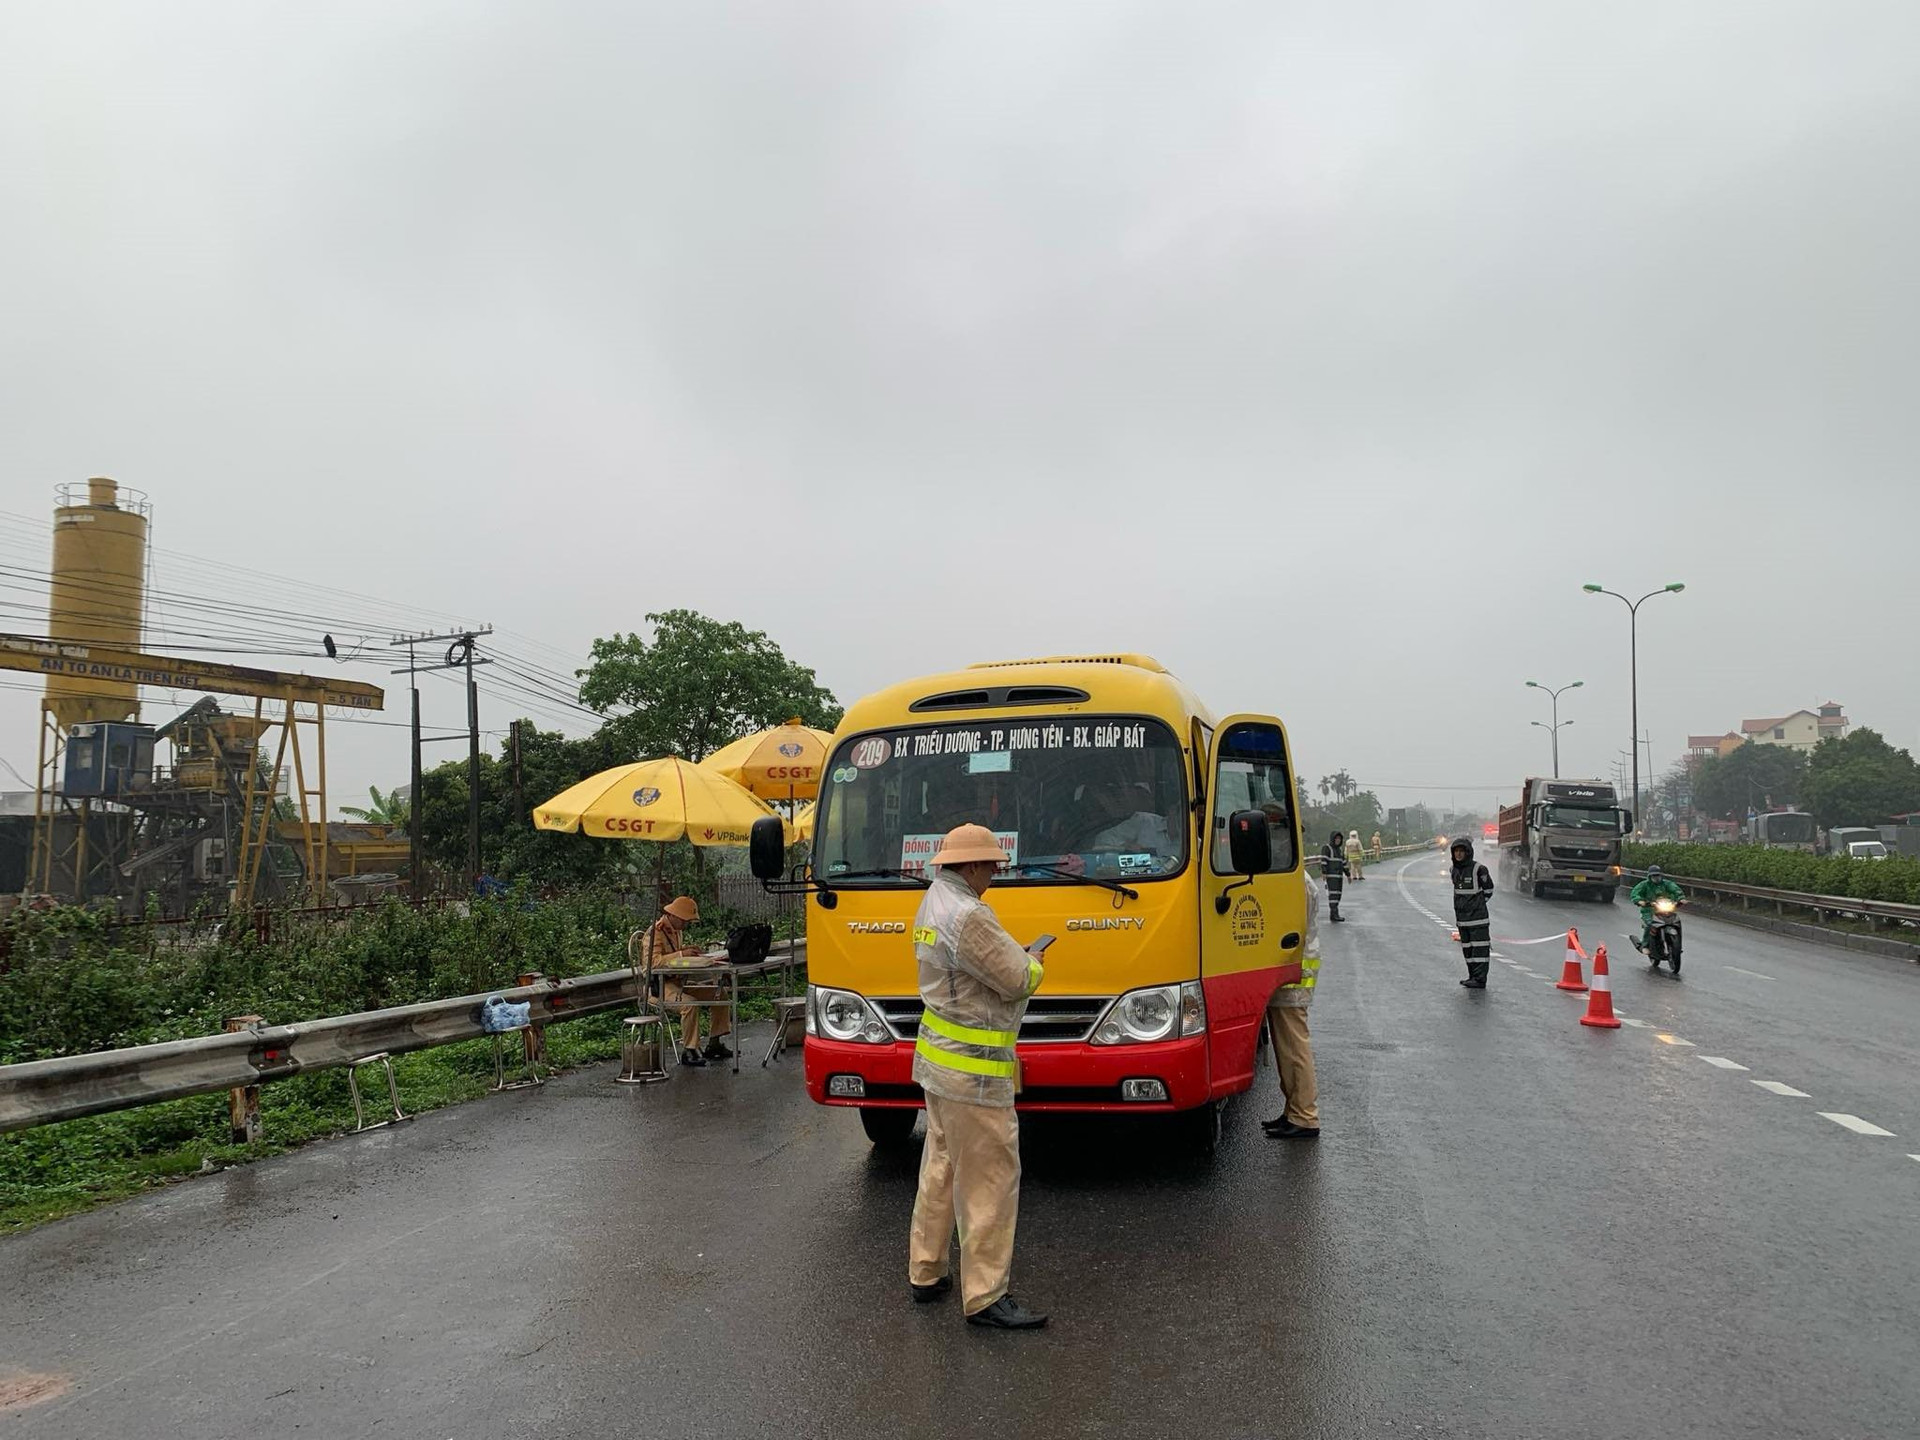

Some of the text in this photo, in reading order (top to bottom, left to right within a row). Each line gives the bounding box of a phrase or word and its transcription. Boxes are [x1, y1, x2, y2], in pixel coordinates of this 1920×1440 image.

[894, 737, 910, 758] BX
[944, 731, 981, 753] DƯƠNG
[991, 730, 1004, 750] TP.
[1009, 727, 1039, 750] HƯNG
[1042, 724, 1064, 748] YÊN
[1073, 727, 1091, 748] BX.
[1094, 722, 1121, 748] GIÁP
[1123, 723, 1145, 748] BÁT
[857, 740, 885, 766] 209
[767, 767, 812, 779] CSGT
[605, 817, 656, 834] CSGT
[717, 831, 749, 842] VPBank
[847, 921, 907, 934] THACO
[1066, 917, 1146, 931] COUNTY
